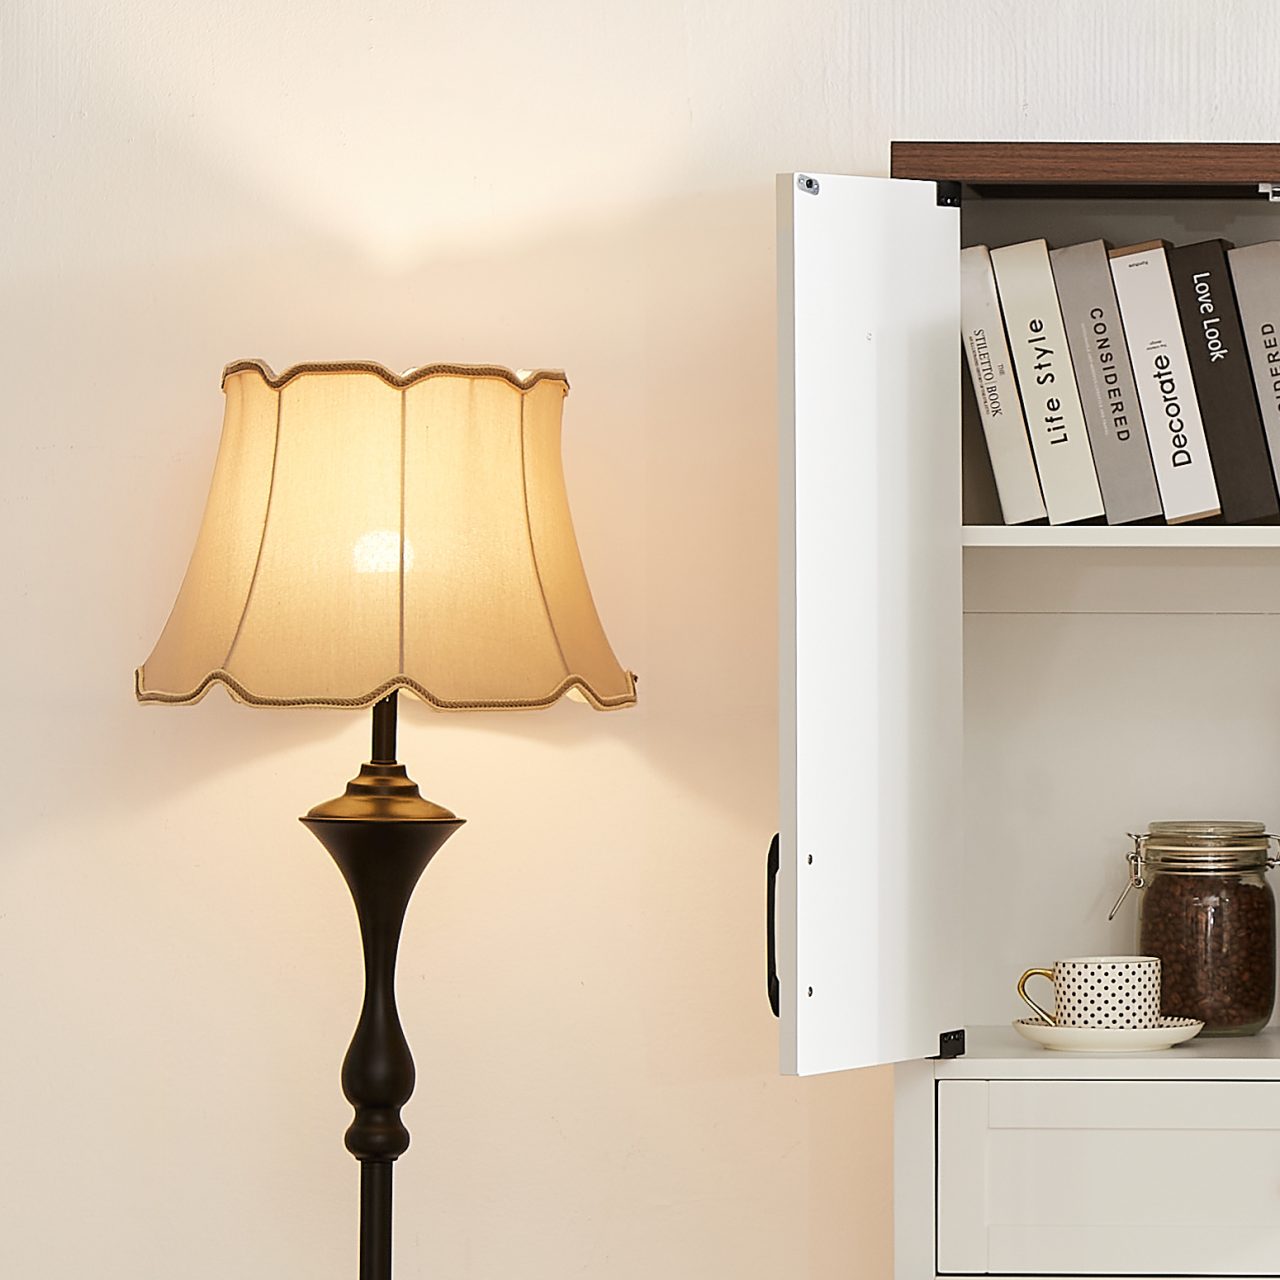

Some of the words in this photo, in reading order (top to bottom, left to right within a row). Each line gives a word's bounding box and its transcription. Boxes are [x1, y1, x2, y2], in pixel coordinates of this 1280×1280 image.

[1193, 272, 1214, 314] Love
[1027, 319, 1055, 384] Style
[1203, 318, 1229, 362] Look
[973, 329, 994, 381] STILETTO
[986, 385, 1003, 417] BOOK
[1090, 307, 1131, 442] CONSIDERED
[1045, 397, 1069, 445] Life
[1153, 355, 1193, 468] Decorate
